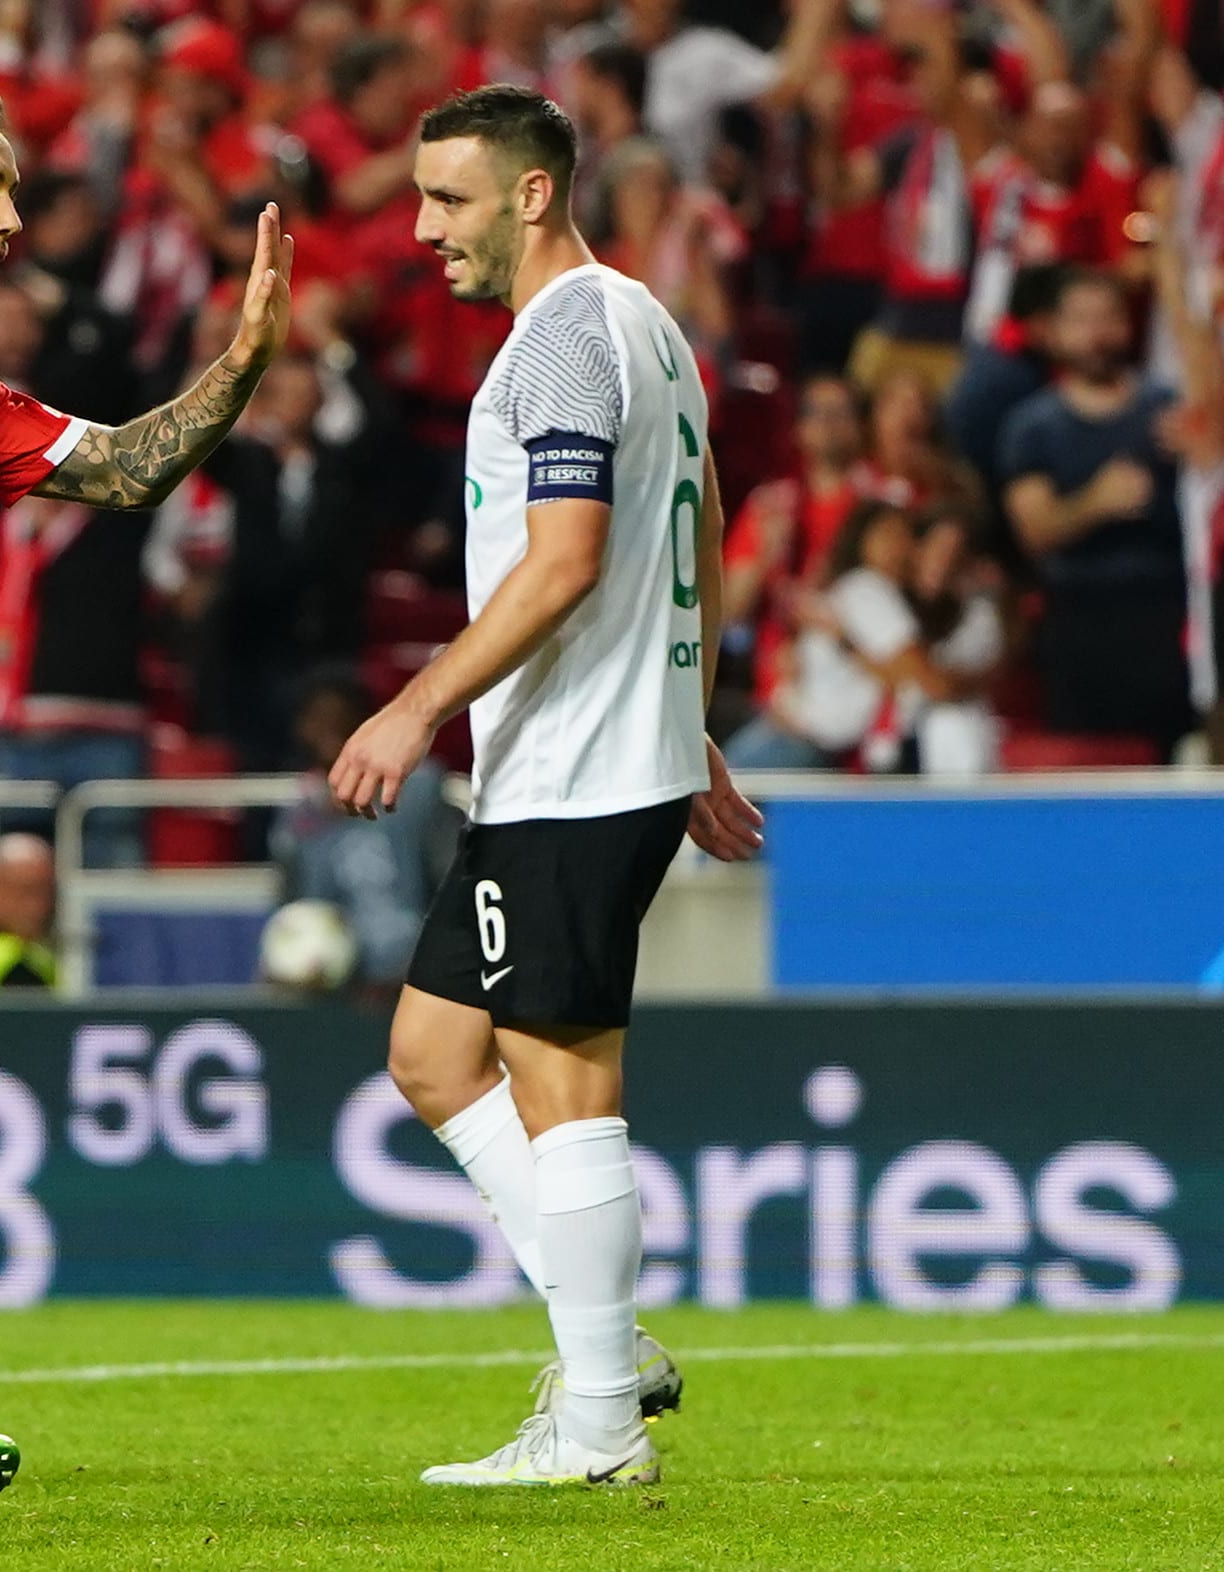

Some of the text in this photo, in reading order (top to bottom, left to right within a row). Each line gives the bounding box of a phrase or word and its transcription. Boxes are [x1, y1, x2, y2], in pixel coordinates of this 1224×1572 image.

[532, 448, 604, 463] NO TO RACISM
[547, 468, 598, 481] RESPECT
[474, 879, 506, 963] 6
[67, 1018, 270, 1167] 5G
